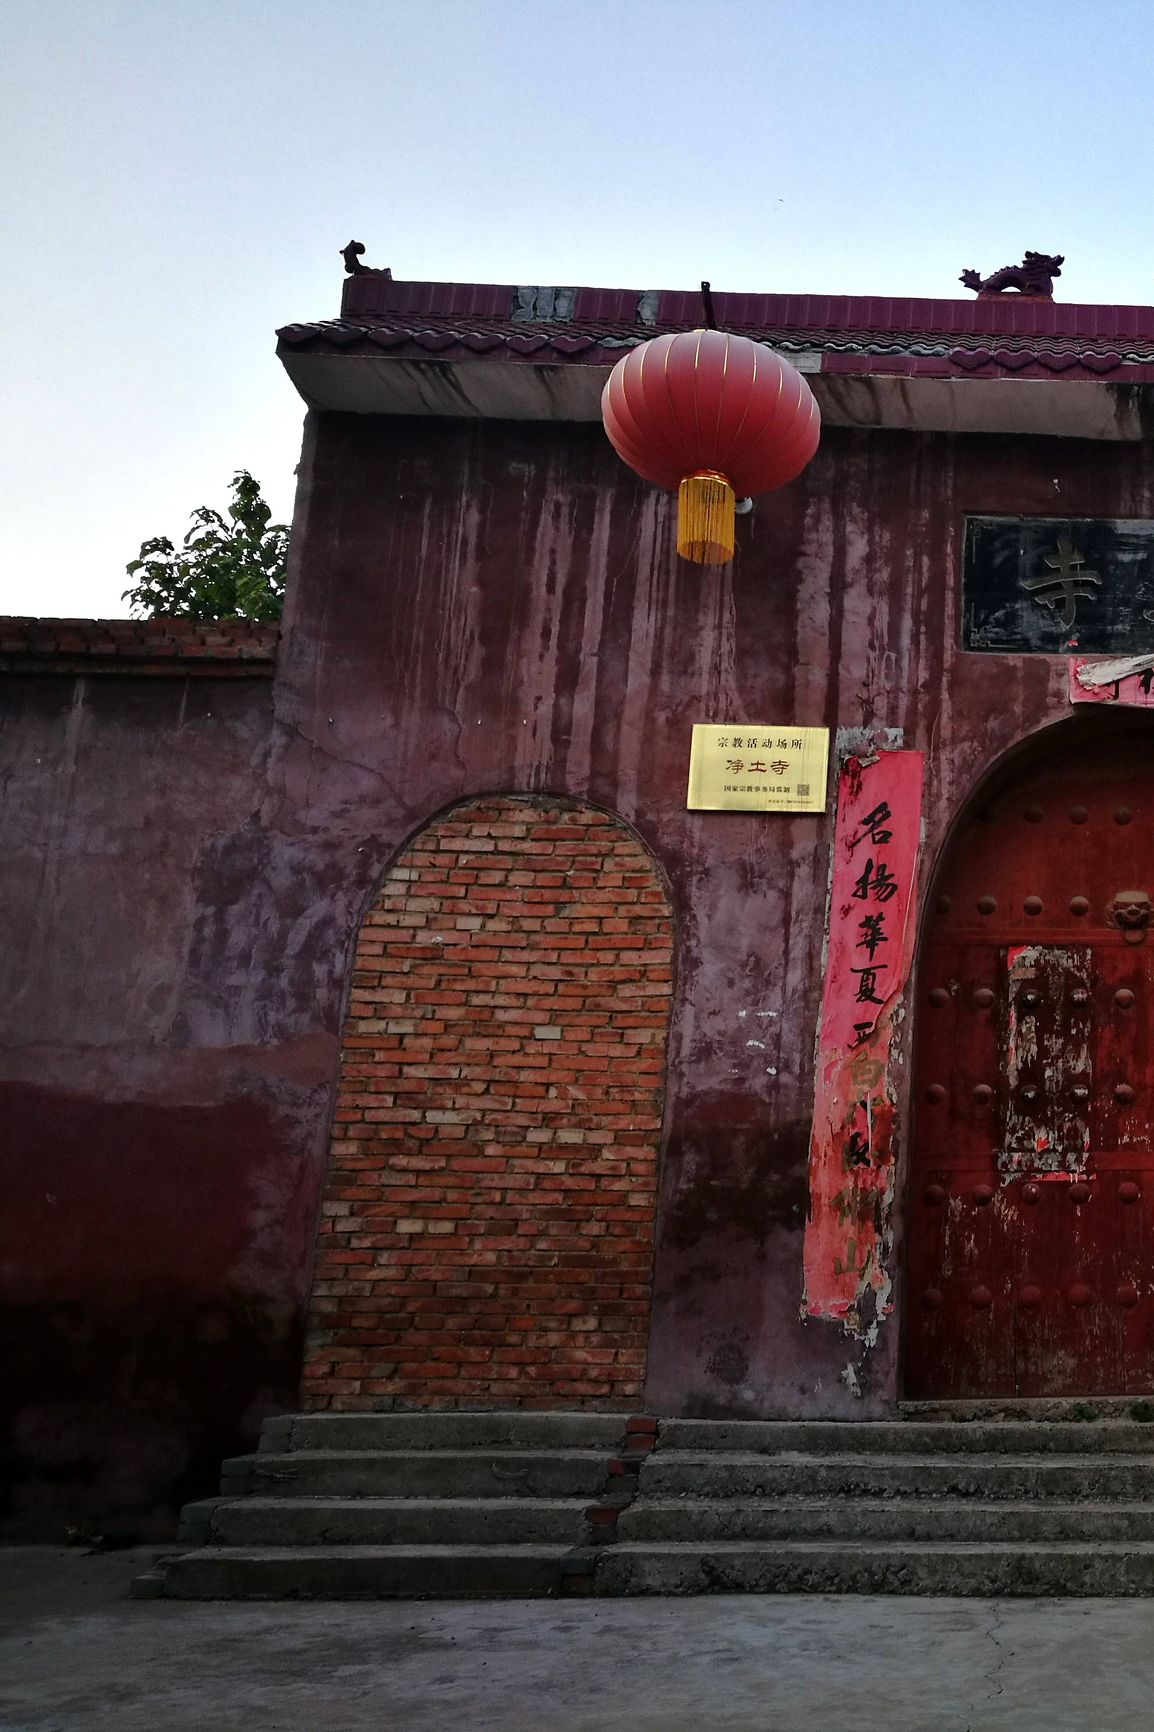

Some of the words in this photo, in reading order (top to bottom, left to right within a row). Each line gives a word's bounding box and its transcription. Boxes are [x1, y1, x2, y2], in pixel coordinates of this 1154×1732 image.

[717, 736, 803, 750] 宗教活动场所
[725, 759, 790, 775] 净土寺
